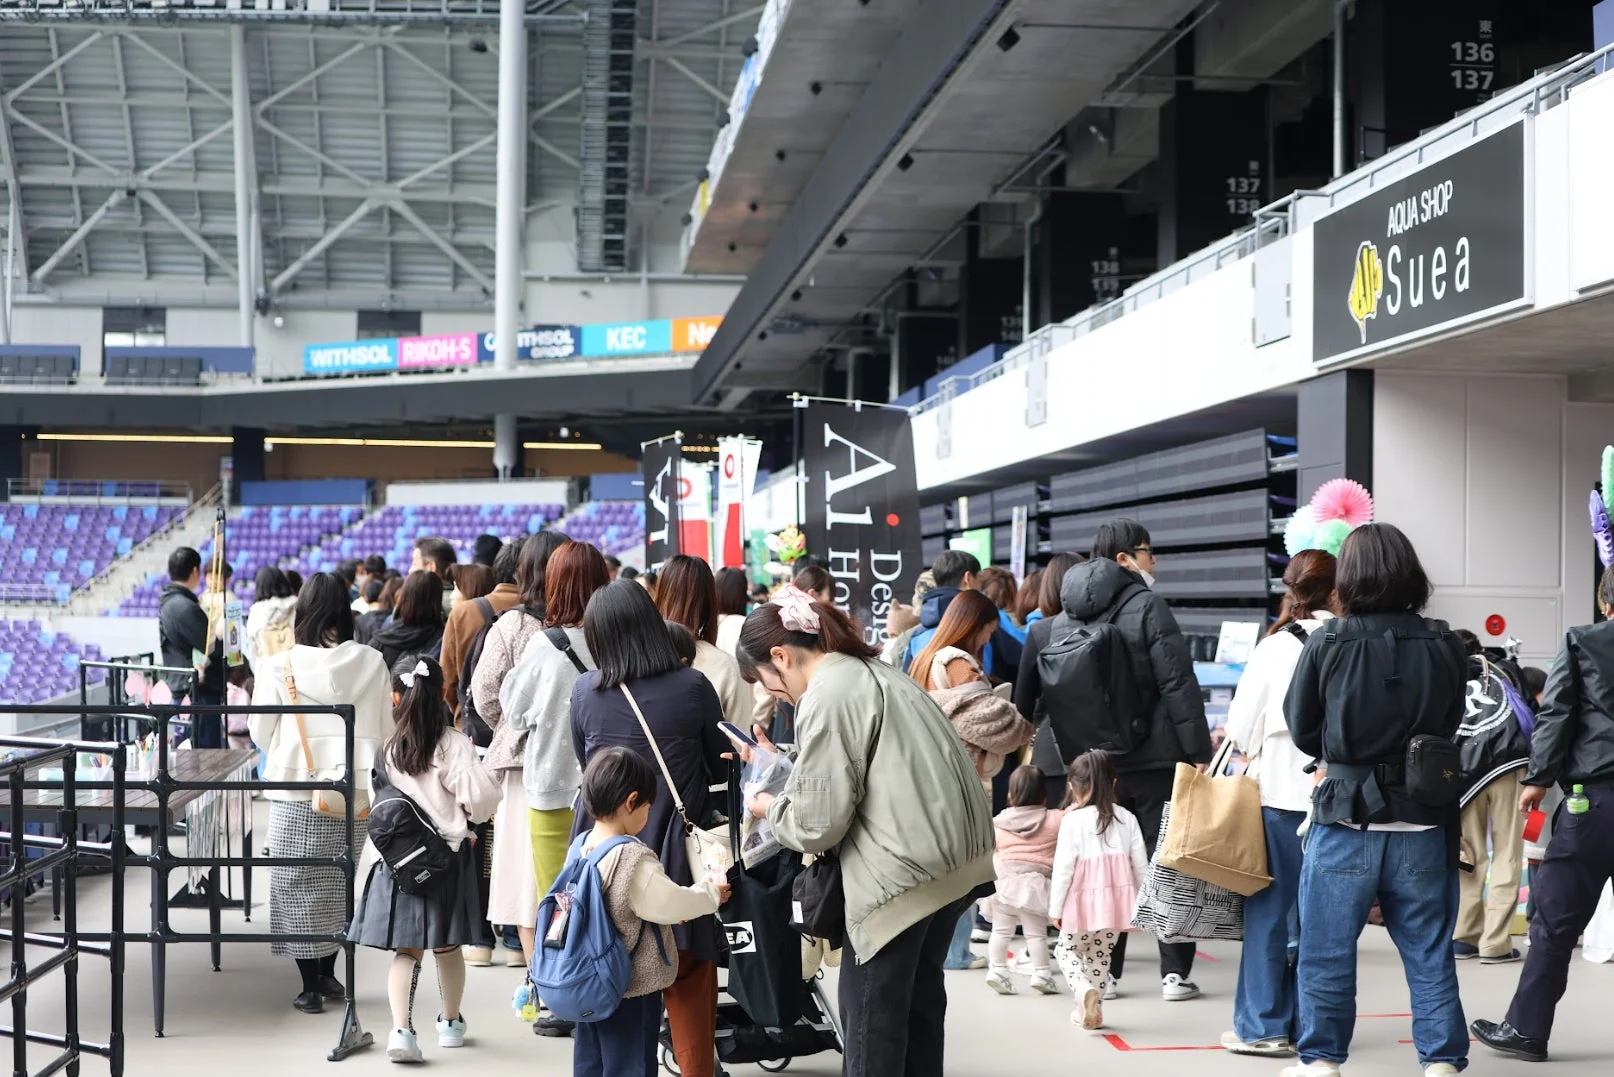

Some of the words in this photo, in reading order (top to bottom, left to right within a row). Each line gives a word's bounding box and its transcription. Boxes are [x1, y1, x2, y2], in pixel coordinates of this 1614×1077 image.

[1450, 41, 1495, 62] 136
[1450, 69, 1495, 90] 137
[1226, 177, 1261, 193] 137
[1386, 196, 1420, 237] AQUA
[1420, 179, 1454, 223] SHOP
[1386, 236, 1470, 316] Suea
[517, 329, 575, 348] ITHSOL
[606, 325, 646, 350] KEC
[310, 345, 392, 367] WITHSOL
[823, 422, 900, 531] Ai
[864, 548, 902, 647] Desig
[725, 930, 751, 945] EA
